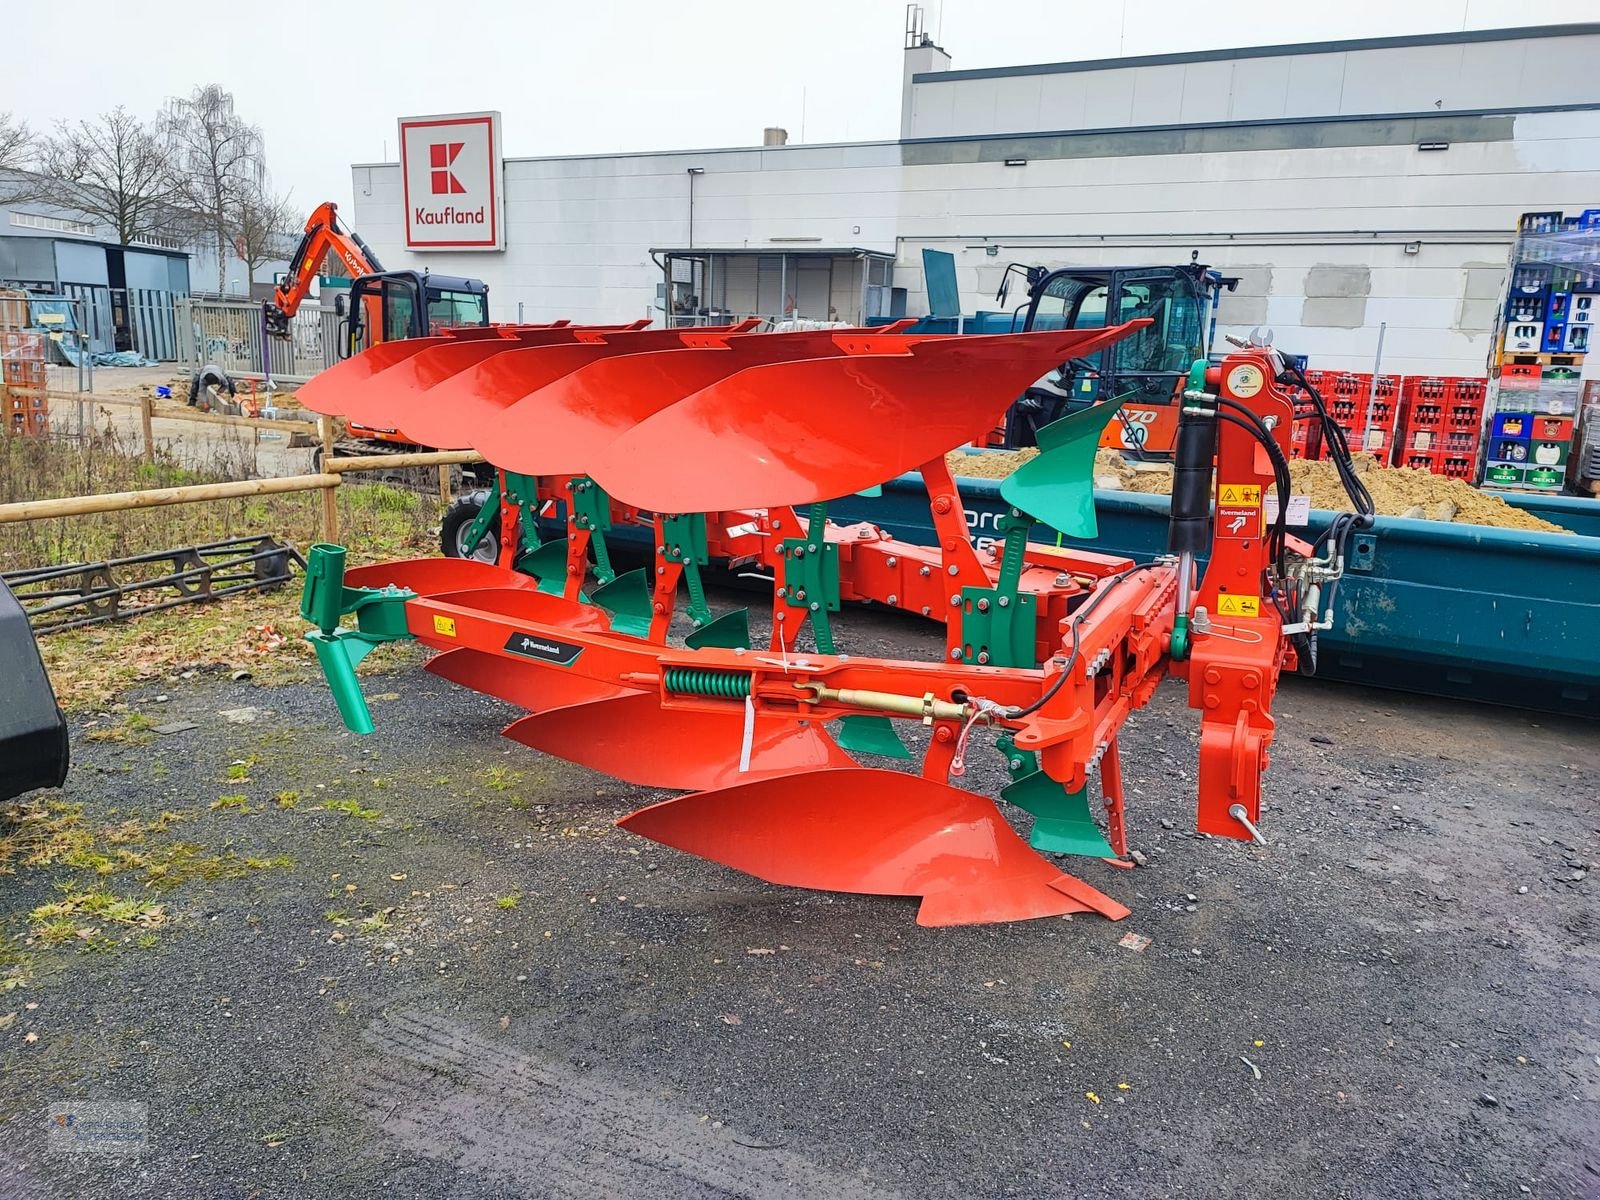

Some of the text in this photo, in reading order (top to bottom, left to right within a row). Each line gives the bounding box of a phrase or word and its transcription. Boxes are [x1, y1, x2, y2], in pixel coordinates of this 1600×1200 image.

[415, 206, 484, 224] Kaufland
[1219, 509, 1257, 517] Kverneland
[529, 641, 560, 655] Kverneland
